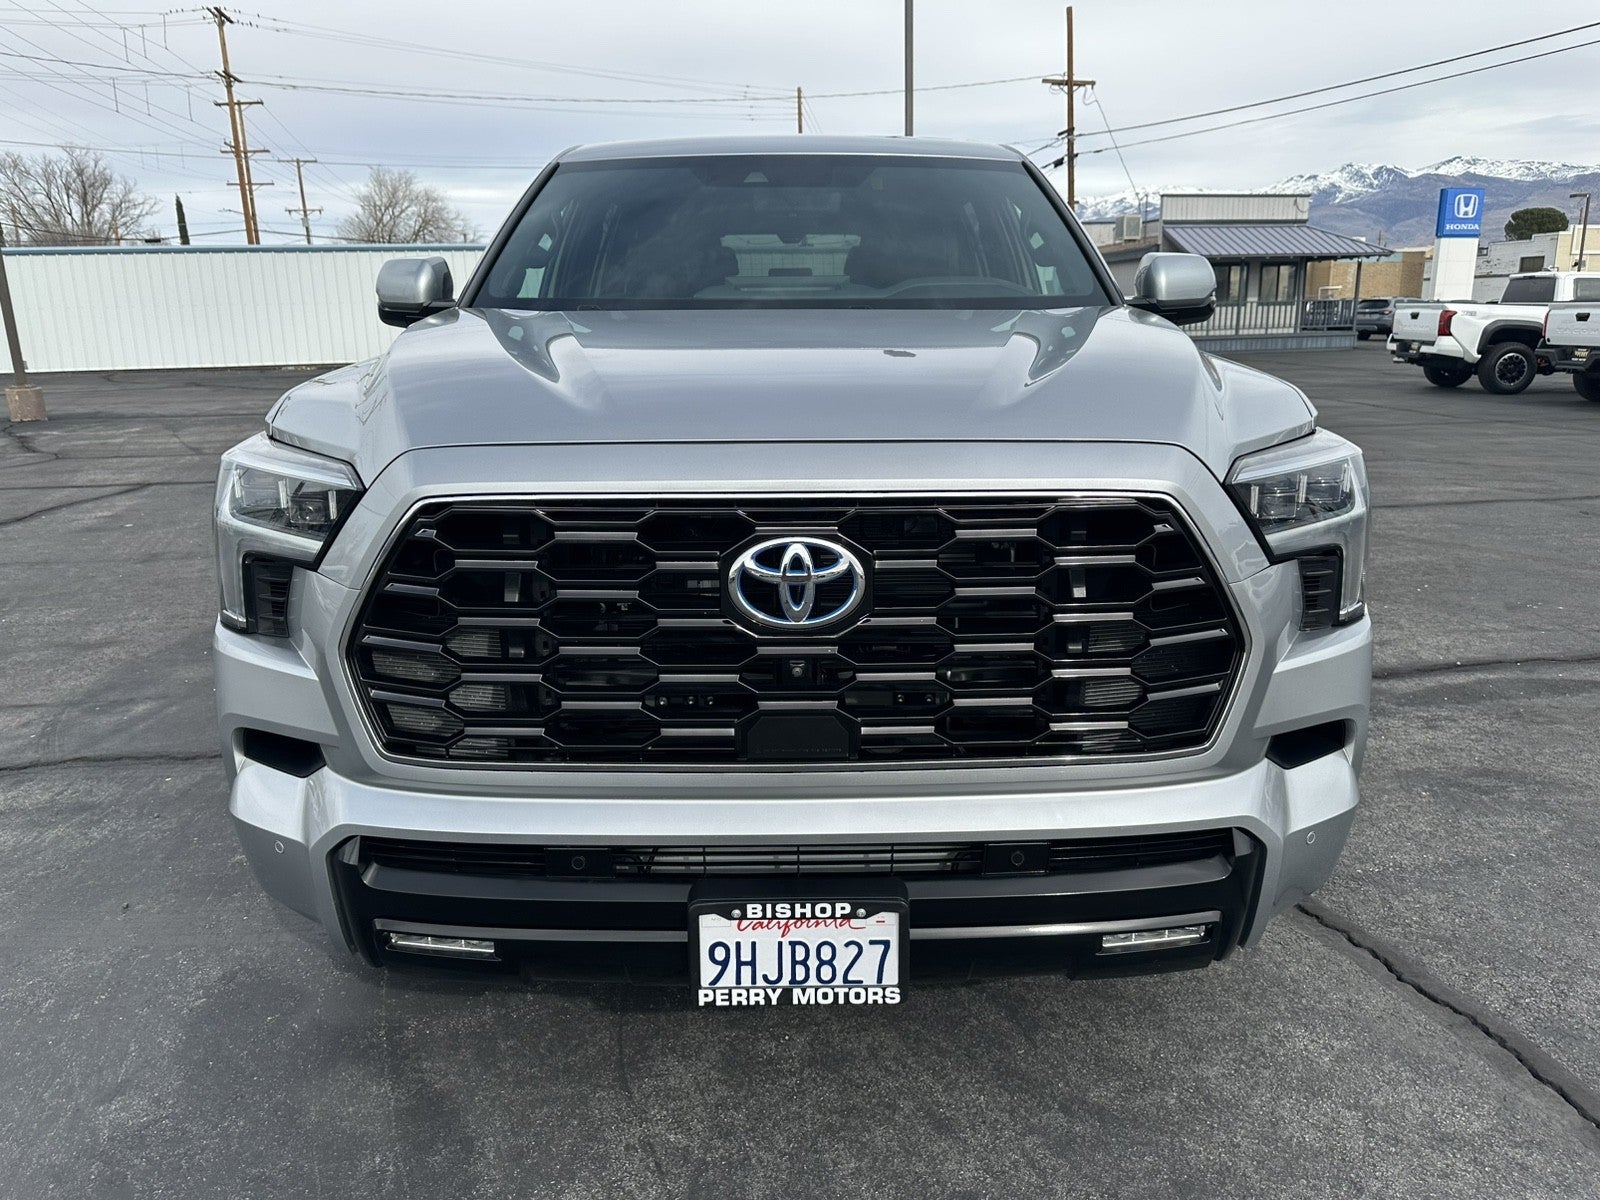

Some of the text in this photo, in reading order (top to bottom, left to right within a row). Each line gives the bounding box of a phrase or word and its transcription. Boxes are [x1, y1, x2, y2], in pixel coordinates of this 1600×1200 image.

[746, 903, 851, 919] BISHOP
[736, 918, 866, 938] California
[708, 939, 891, 986] 9HJB827
[698, 987, 901, 1006] PERRY MOTORS
